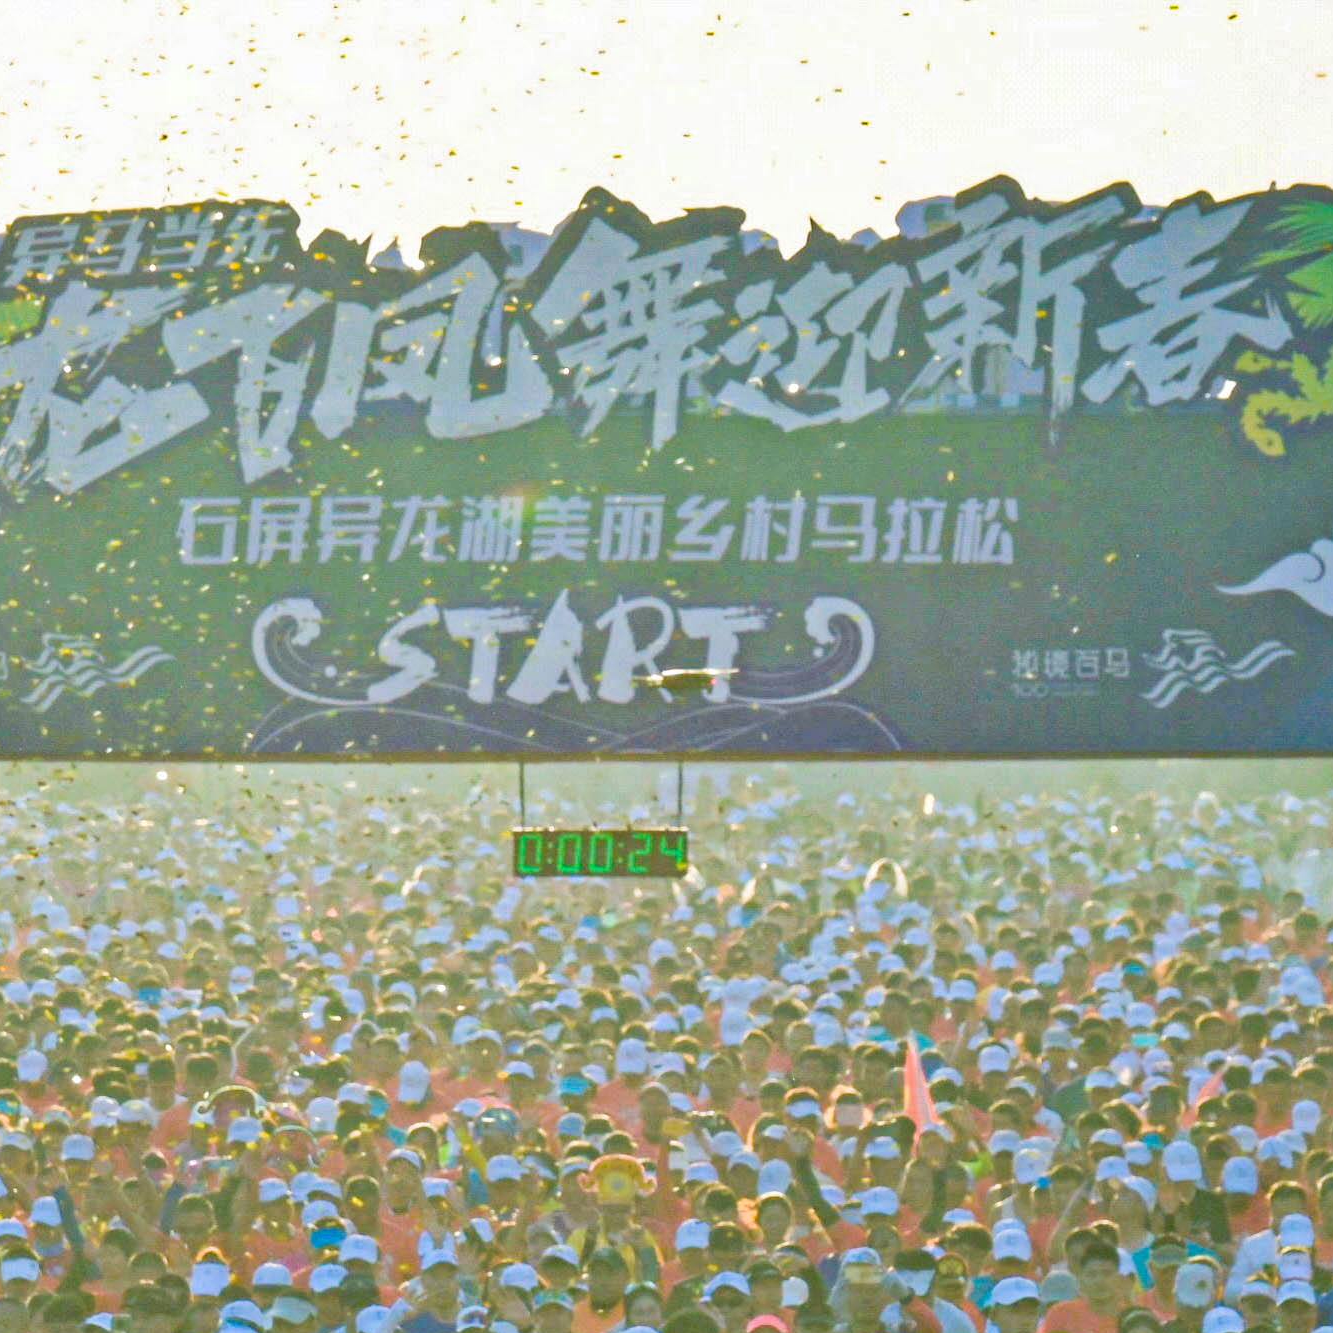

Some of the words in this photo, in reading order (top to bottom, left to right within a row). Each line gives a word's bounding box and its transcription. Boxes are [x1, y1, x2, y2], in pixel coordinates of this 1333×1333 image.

[177, 495, 1019, 565] 石屏异龙湖美丽乡村马拉松
[367, 588, 773, 704] START
